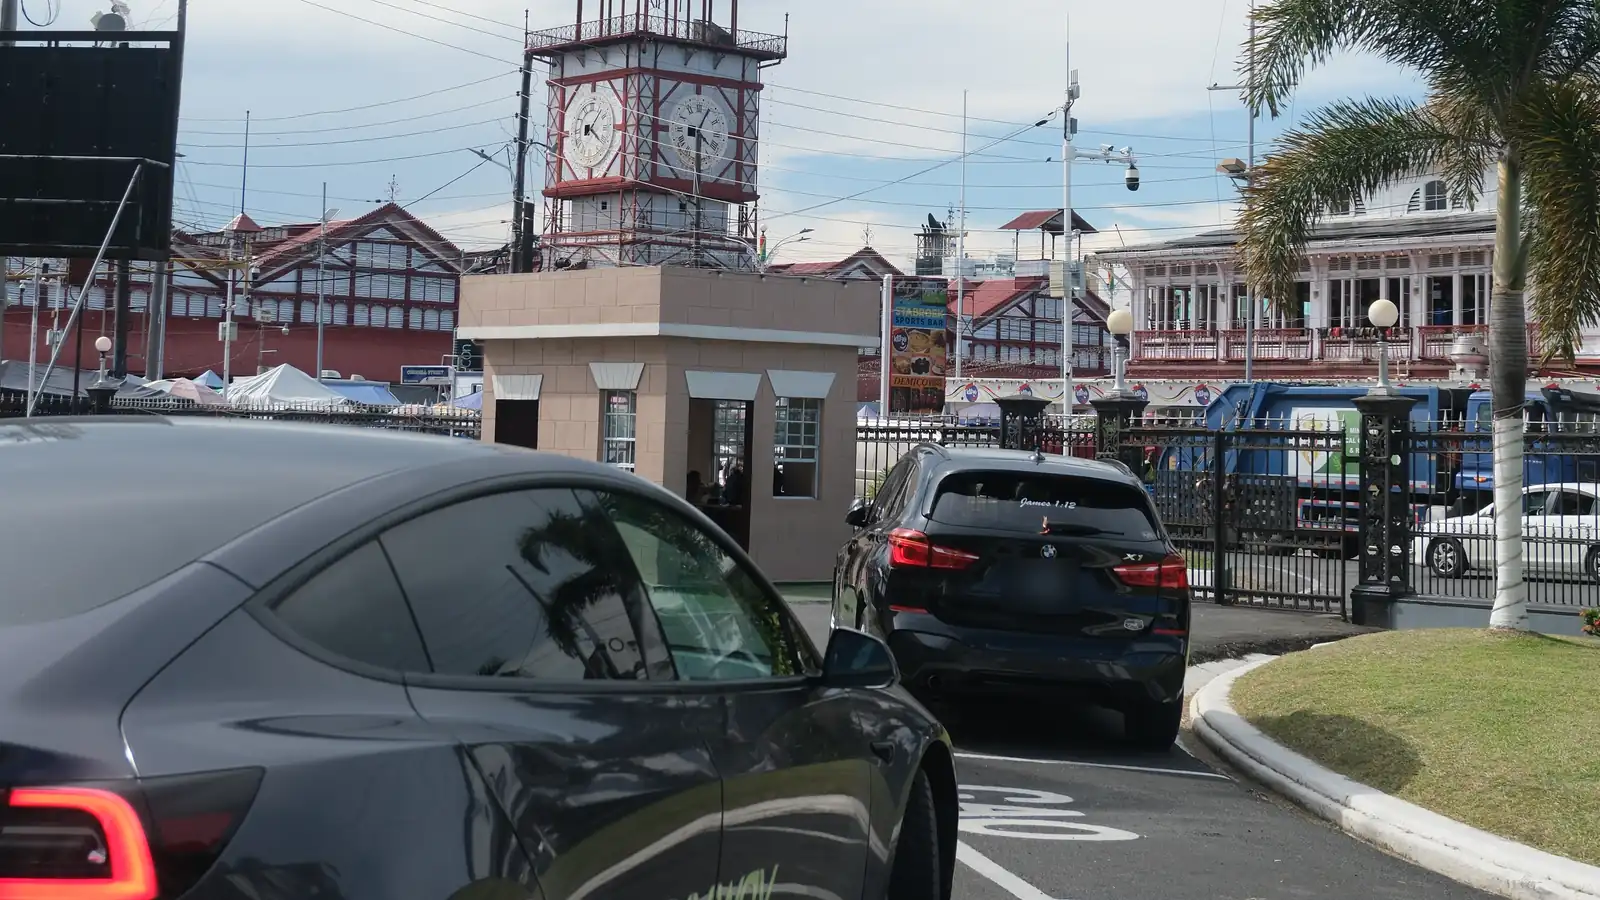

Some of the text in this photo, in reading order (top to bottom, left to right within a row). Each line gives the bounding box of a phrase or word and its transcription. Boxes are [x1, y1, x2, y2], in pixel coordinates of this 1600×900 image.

[895, 317, 944, 327] SPORTS BAR
[1019, 497, 1077, 510] James 1:12
[1122, 553, 1144, 561] X1
